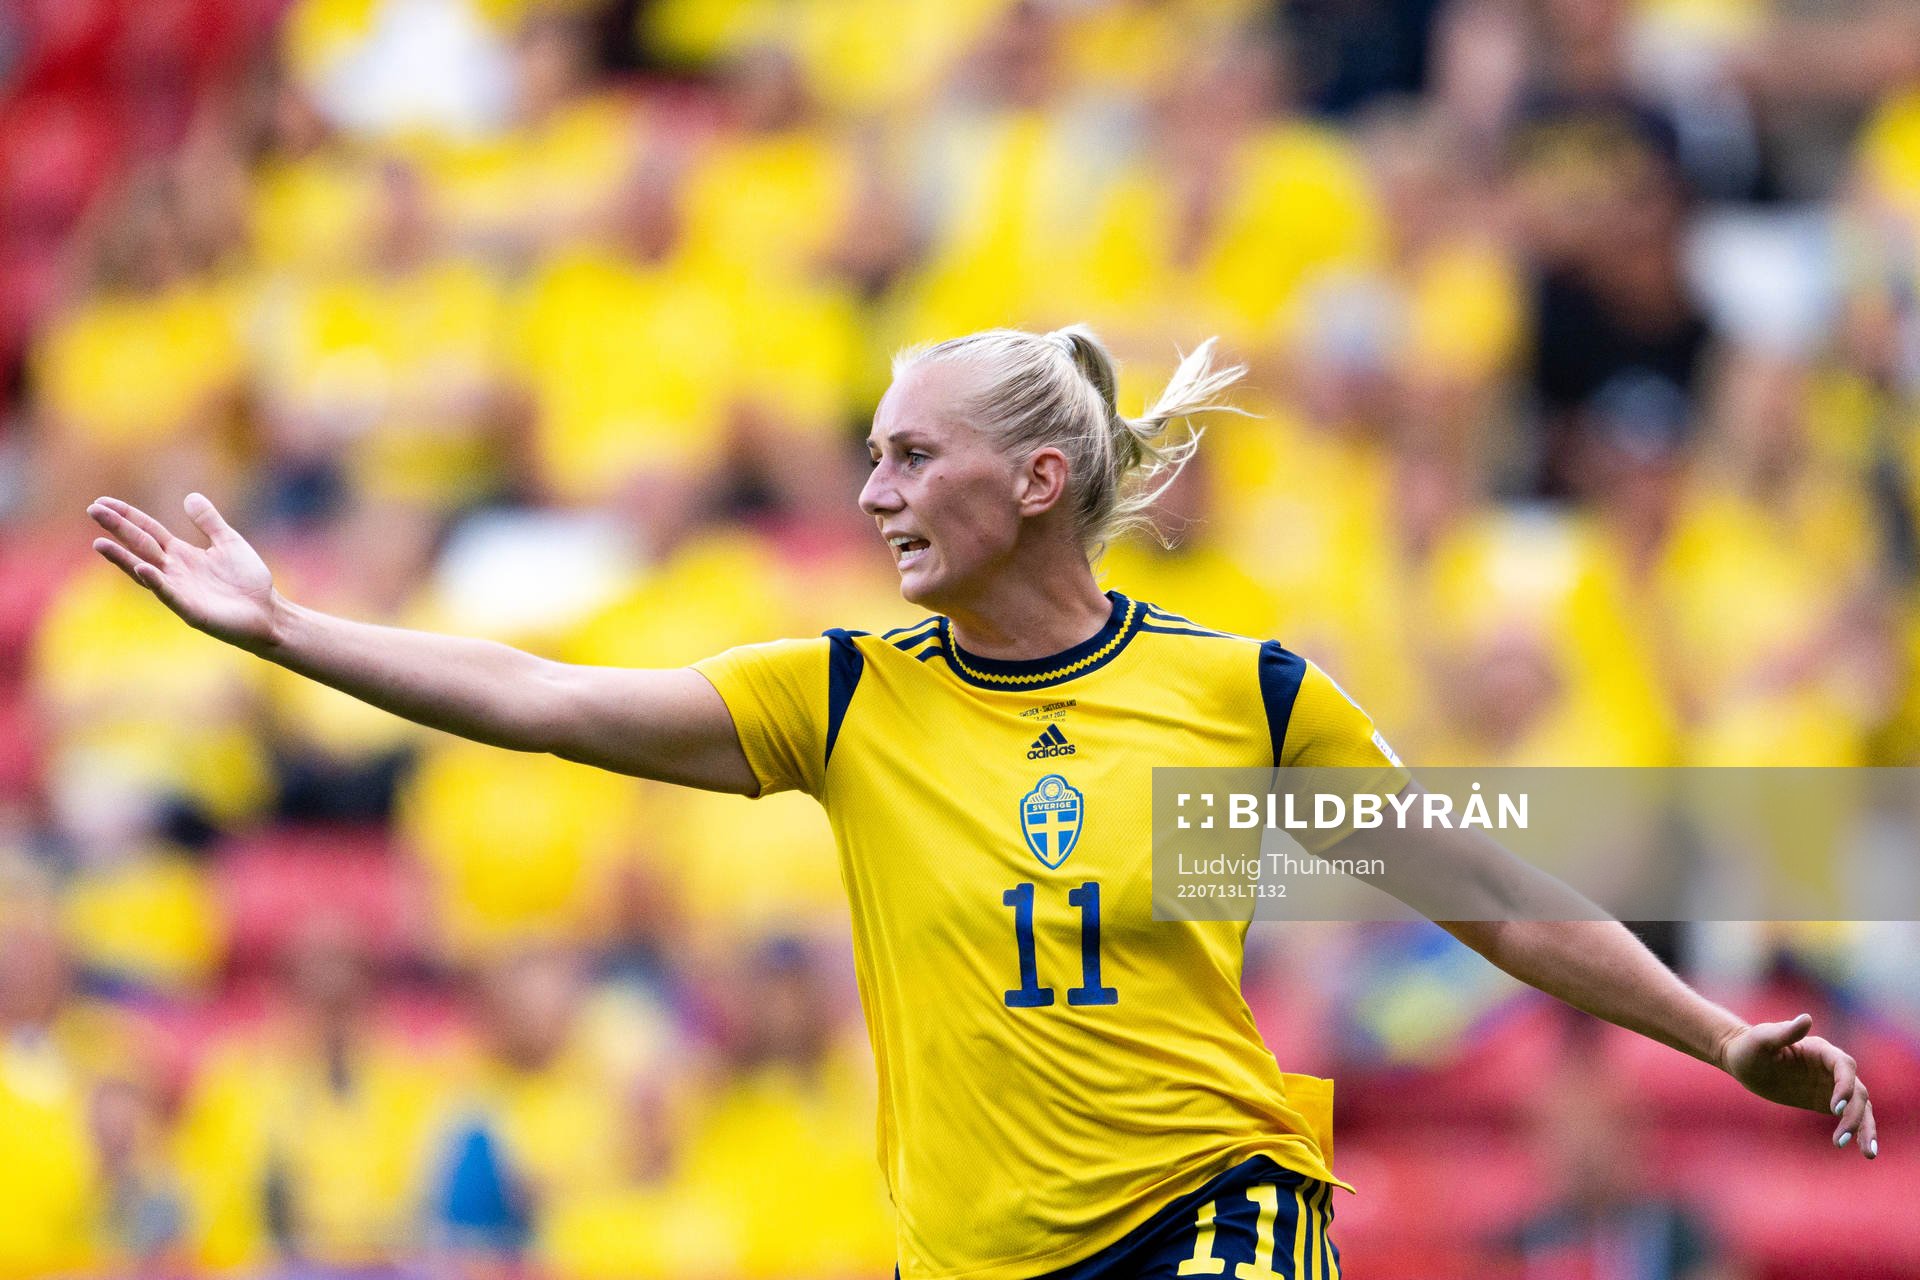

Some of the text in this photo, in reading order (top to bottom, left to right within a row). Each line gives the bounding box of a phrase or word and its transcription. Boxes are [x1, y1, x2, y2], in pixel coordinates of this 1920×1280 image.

[1027, 744, 1076, 760] adidas
[1032, 801, 1072, 811] SVERIGE
[1003, 882, 1118, 1007] 11
[1177, 1182, 1285, 1280] 11
